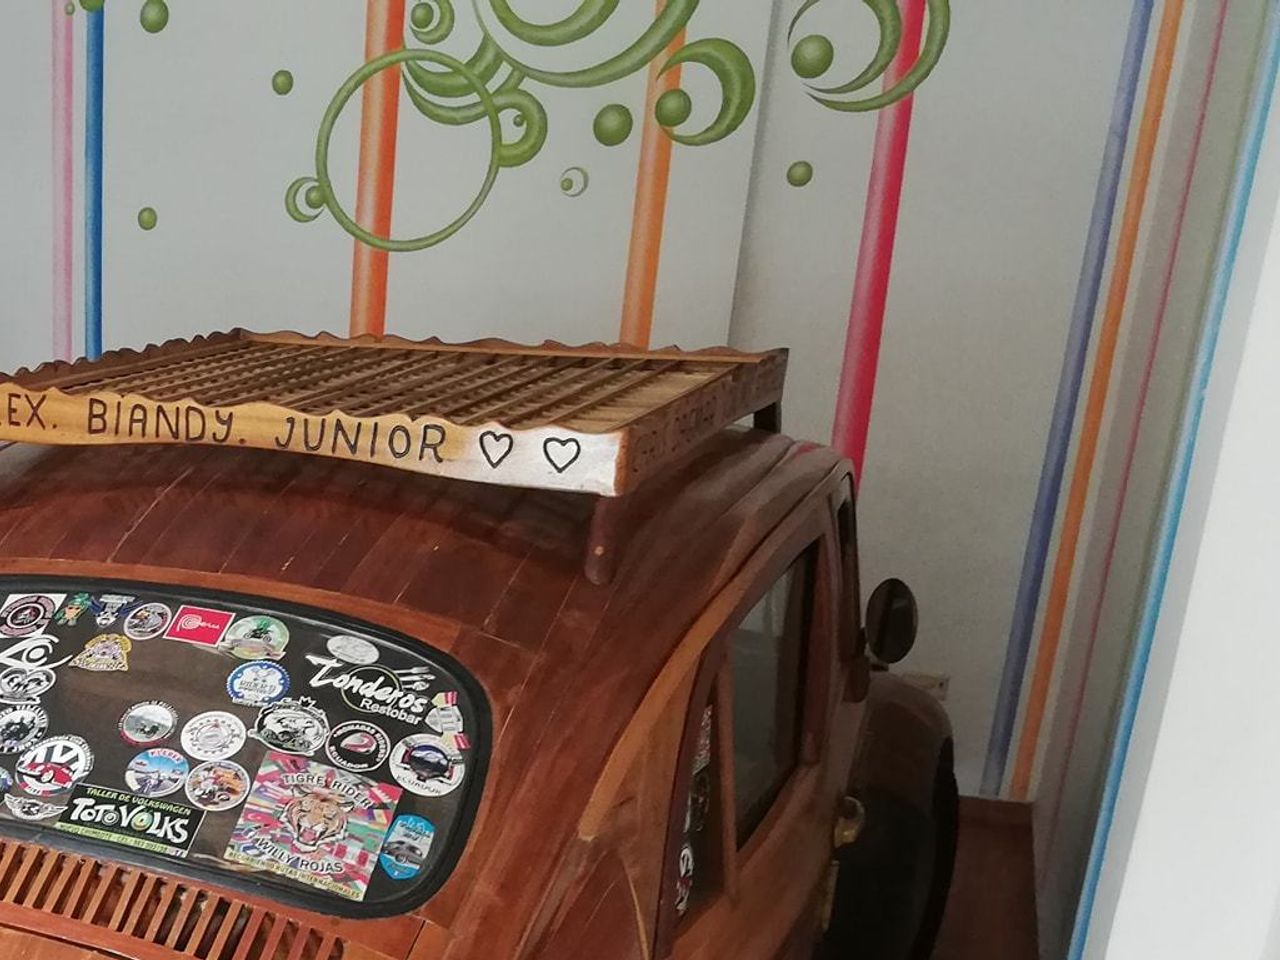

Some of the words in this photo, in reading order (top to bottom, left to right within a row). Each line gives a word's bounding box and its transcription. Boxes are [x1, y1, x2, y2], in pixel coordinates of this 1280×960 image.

[274, 415, 444, 463] JUNIOR
[359, 698, 423, 725] Restobar
[328, 745, 369, 769] ECUADOR
[281, 772, 324, 786] TIGRE
[86, 787, 117, 801] TALLER
[118, 792, 131, 803] DE
[131, 795, 192, 816] VOLKSWAGEN
[255, 836, 296, 864] WILLY
[299, 857, 344, 874] ROJAS
